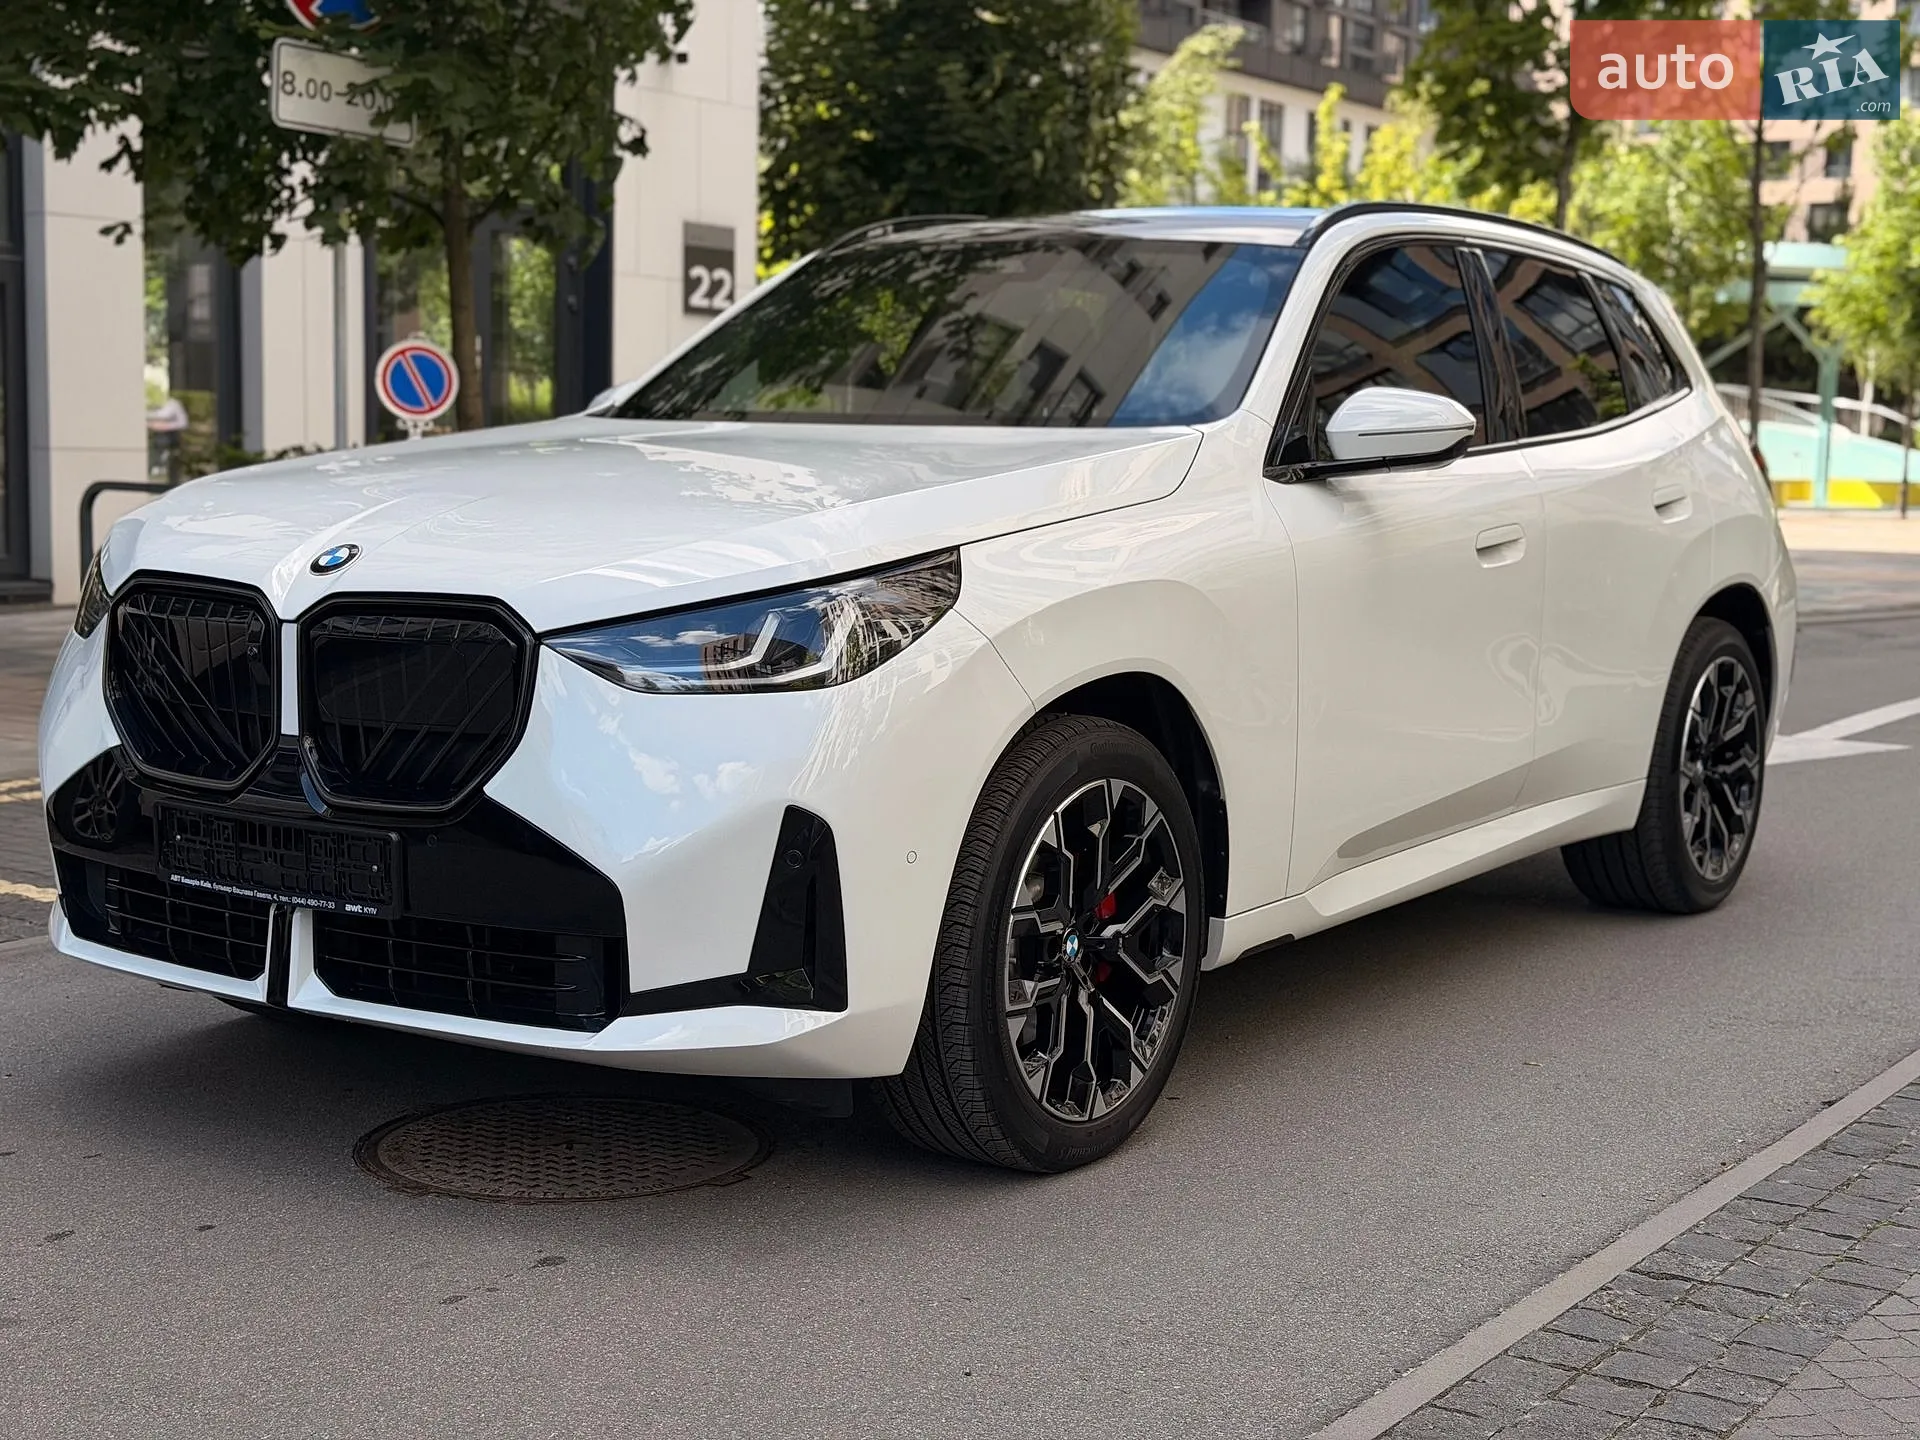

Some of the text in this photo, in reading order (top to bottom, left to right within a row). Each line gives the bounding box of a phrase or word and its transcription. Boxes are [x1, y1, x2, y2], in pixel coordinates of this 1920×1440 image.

[688, 264, 733, 309] 22
[291, 896, 307, 906] (044)
[345, 903, 378, 915] awt KYIV
